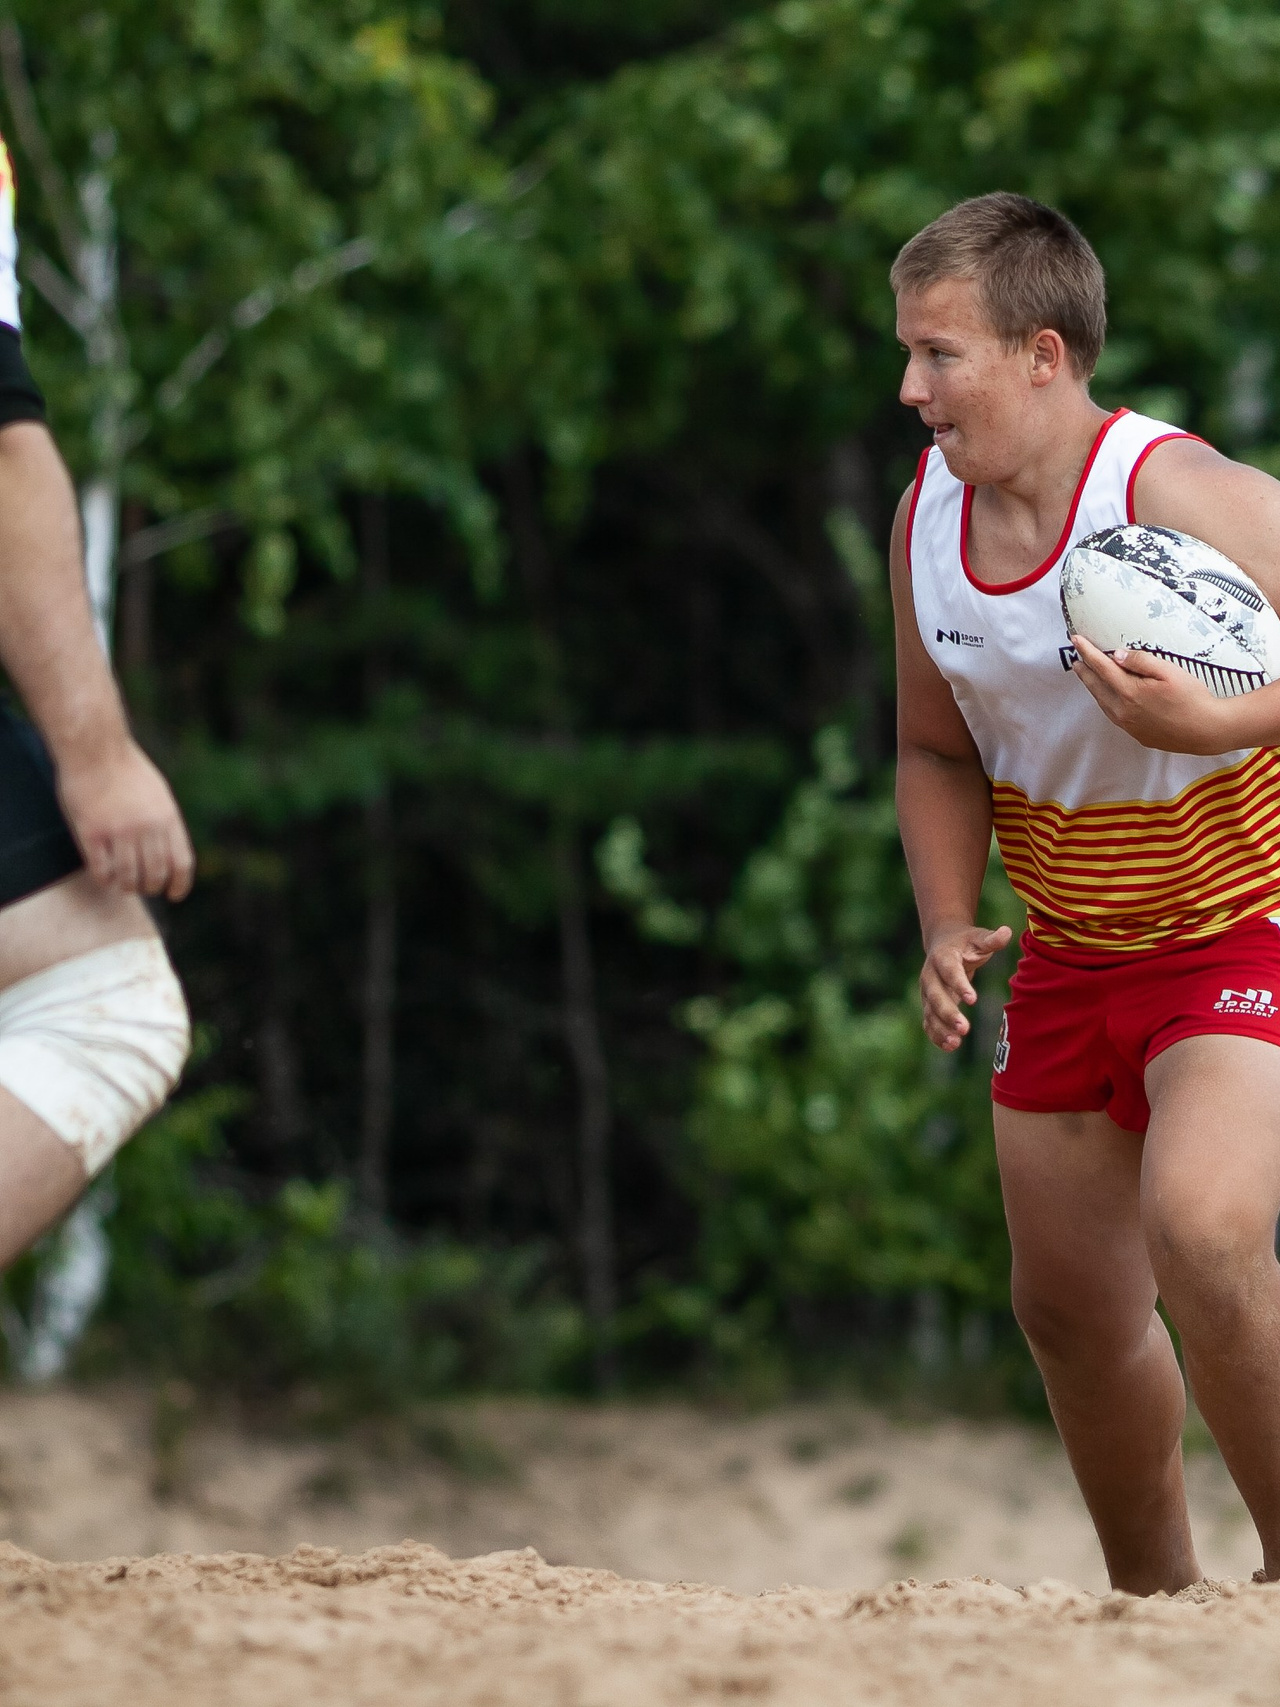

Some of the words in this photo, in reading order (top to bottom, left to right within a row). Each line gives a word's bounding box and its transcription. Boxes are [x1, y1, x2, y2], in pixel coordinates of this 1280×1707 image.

[961, 633, 985, 644] SPORT
[1213, 1000, 1279, 1015] SPORT
[1218, 1008, 1273, 1018] LABORATORY
